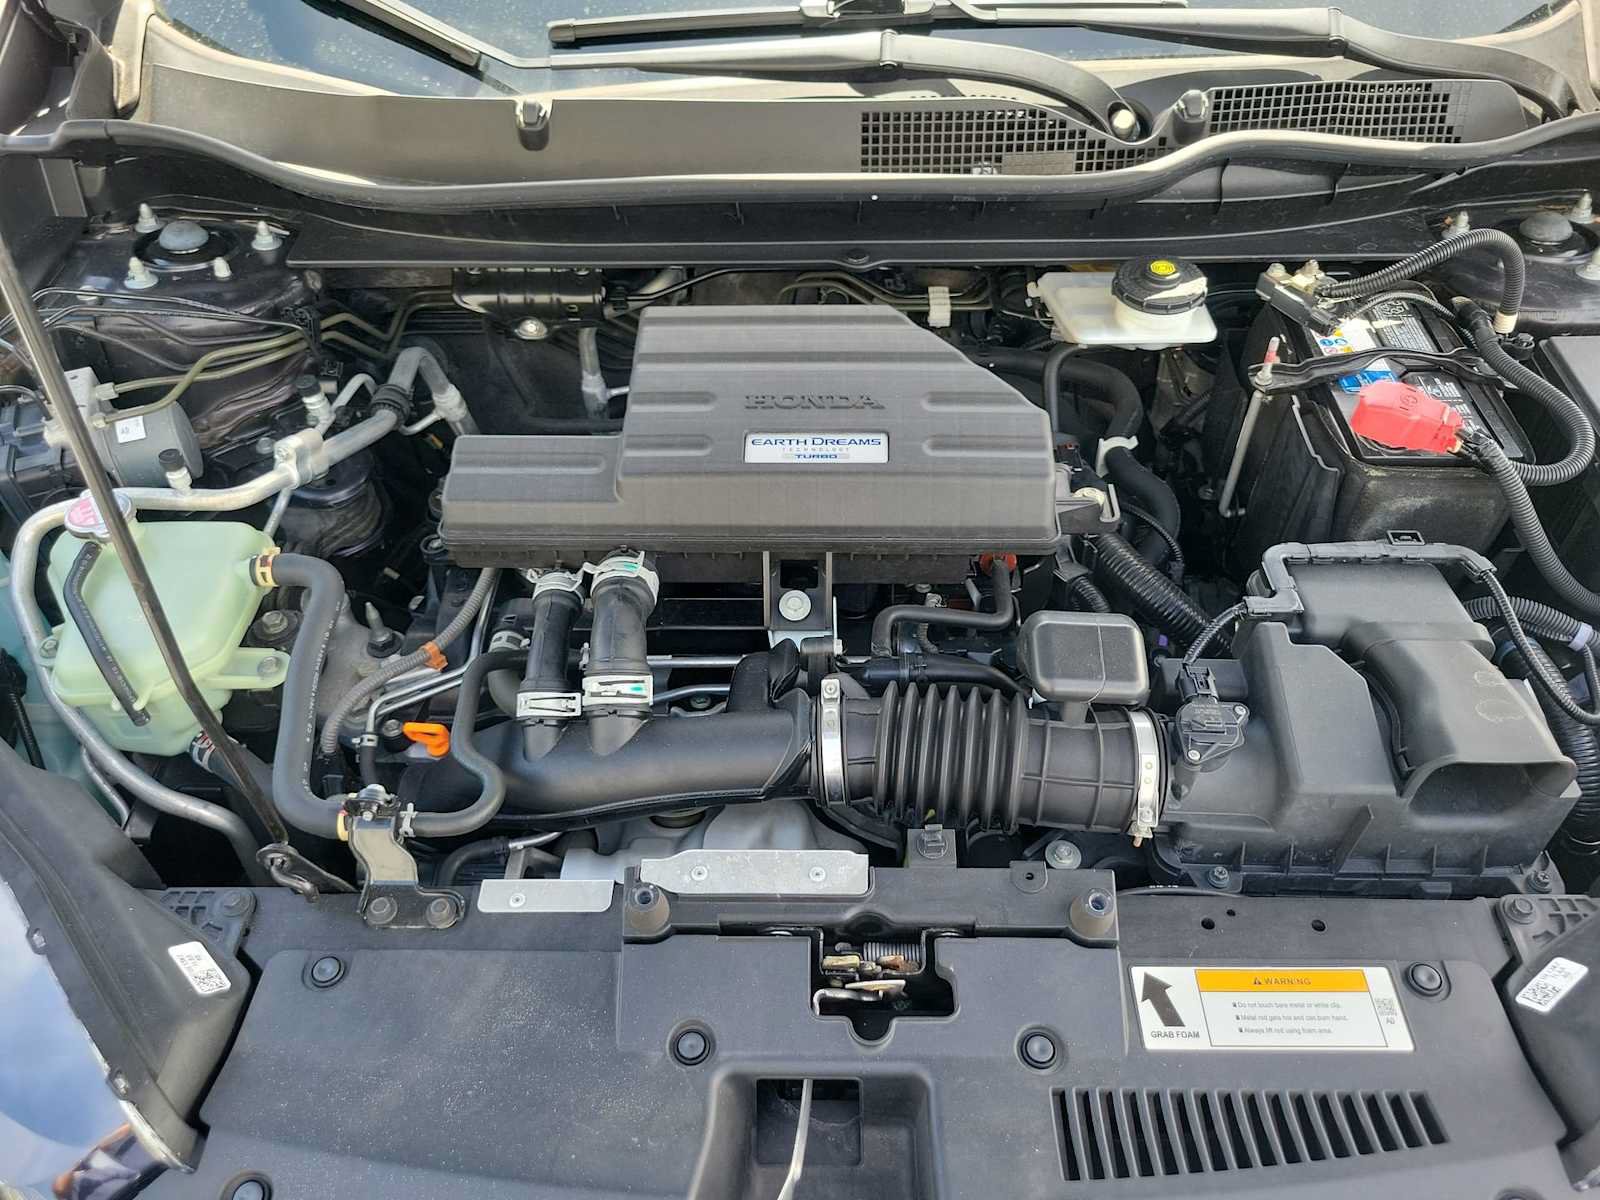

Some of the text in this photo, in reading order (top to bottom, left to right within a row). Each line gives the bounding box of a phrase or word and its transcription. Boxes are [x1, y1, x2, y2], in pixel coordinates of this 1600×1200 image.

[744, 394, 886, 410] HONDA
[751, 436, 882, 447] EARTH DREAMS
[1264, 976, 1312, 986] WARNING
[1247, 1001, 1256, 1009] not
[1150, 1030, 1200, 1039] GRAB FOAM
